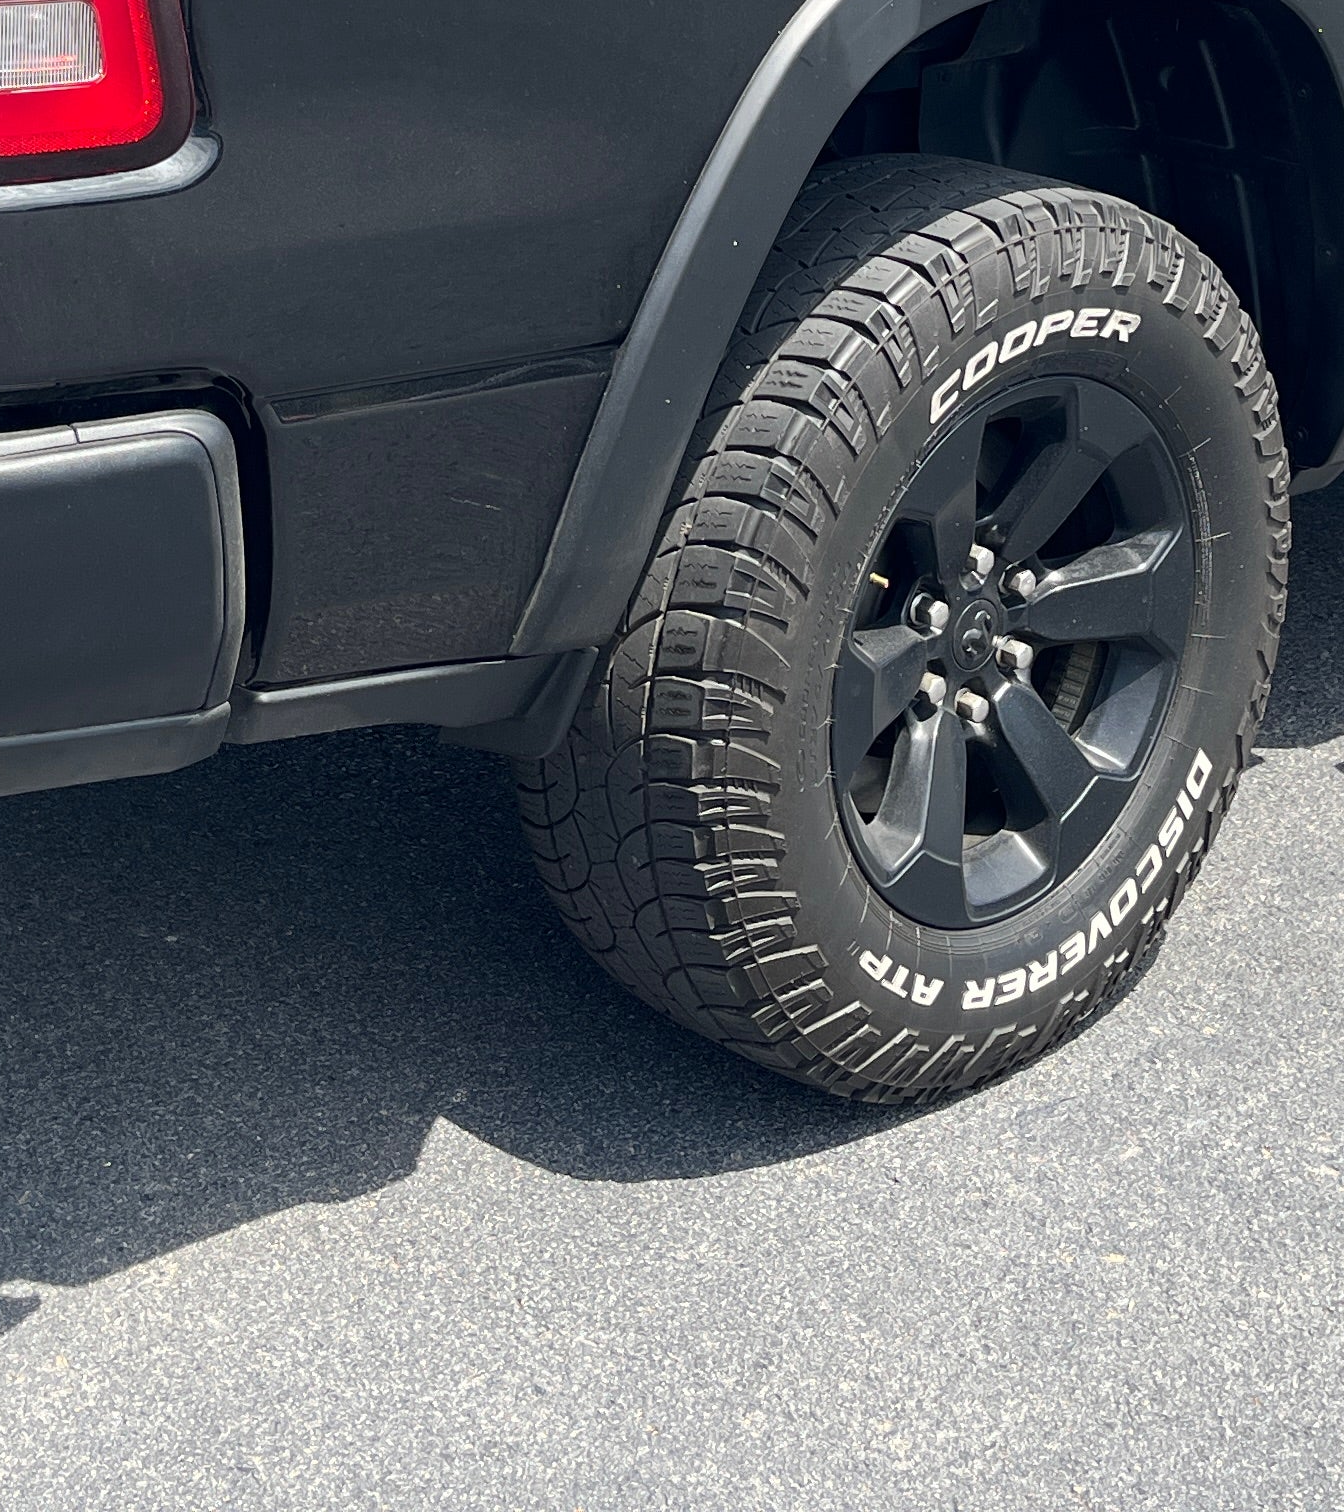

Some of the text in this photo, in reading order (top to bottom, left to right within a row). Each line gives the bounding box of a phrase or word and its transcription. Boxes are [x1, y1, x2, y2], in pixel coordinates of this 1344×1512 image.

[929, 307, 1142, 424] COOPER
[961, 747, 1214, 1011] DISCOVERER
[859, 949, 945, 1007] ATP
